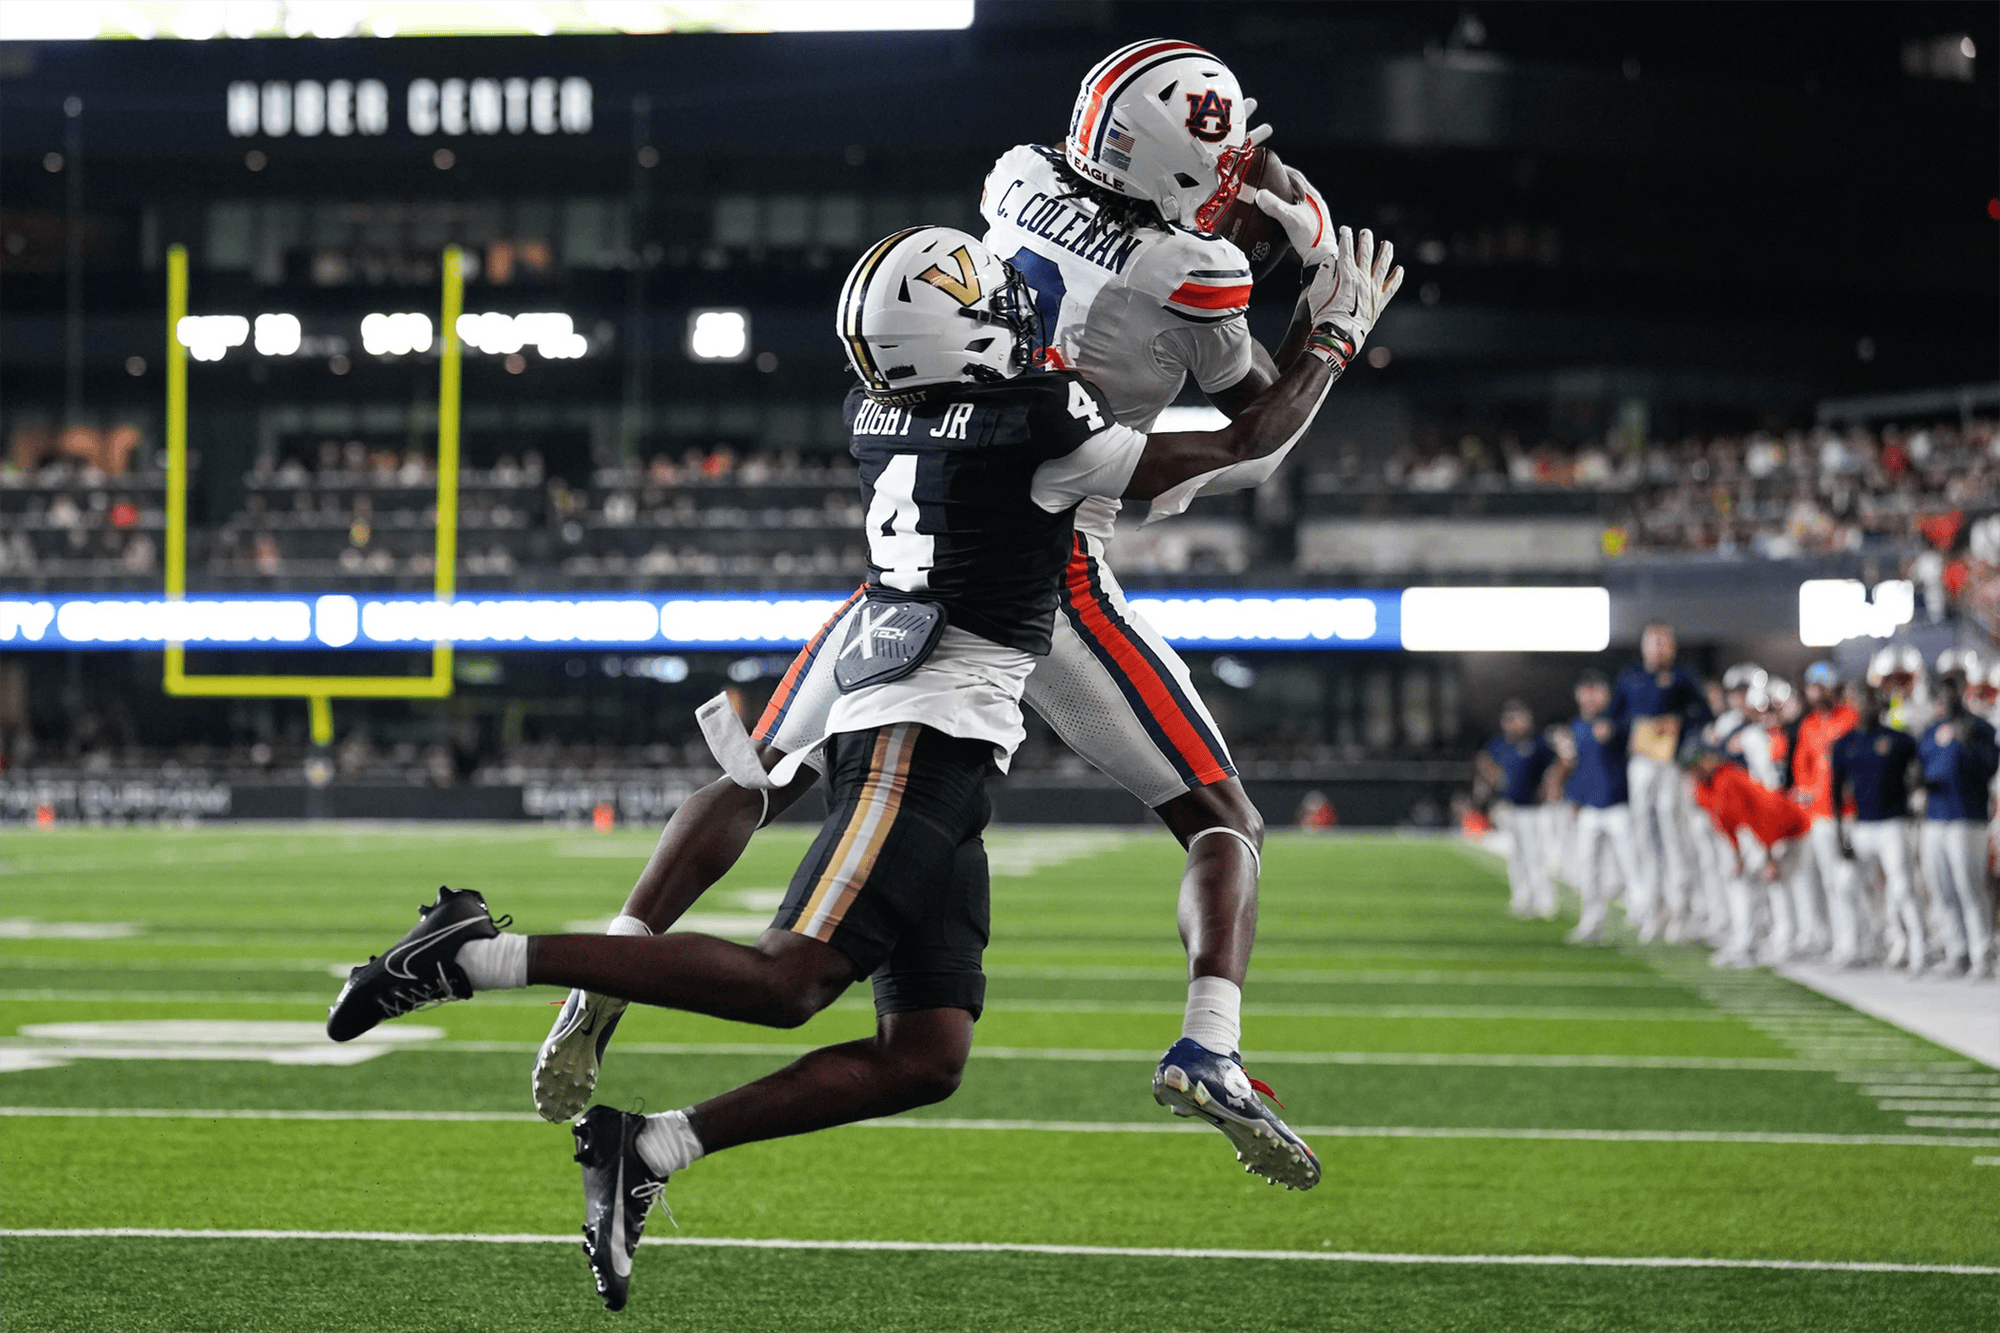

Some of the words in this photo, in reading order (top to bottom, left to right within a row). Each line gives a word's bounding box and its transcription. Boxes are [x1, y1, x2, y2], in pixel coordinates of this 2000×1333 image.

[1074, 157, 1125, 192] EAGLE
[997, 179, 1024, 218] C.
[1016, 192, 1142, 275] COLEMAN
[914, 244, 982, 307] V
[930, 403, 974, 440] JR
[1066, 380, 1106, 432] 4
[866, 454, 935, 592] 4
